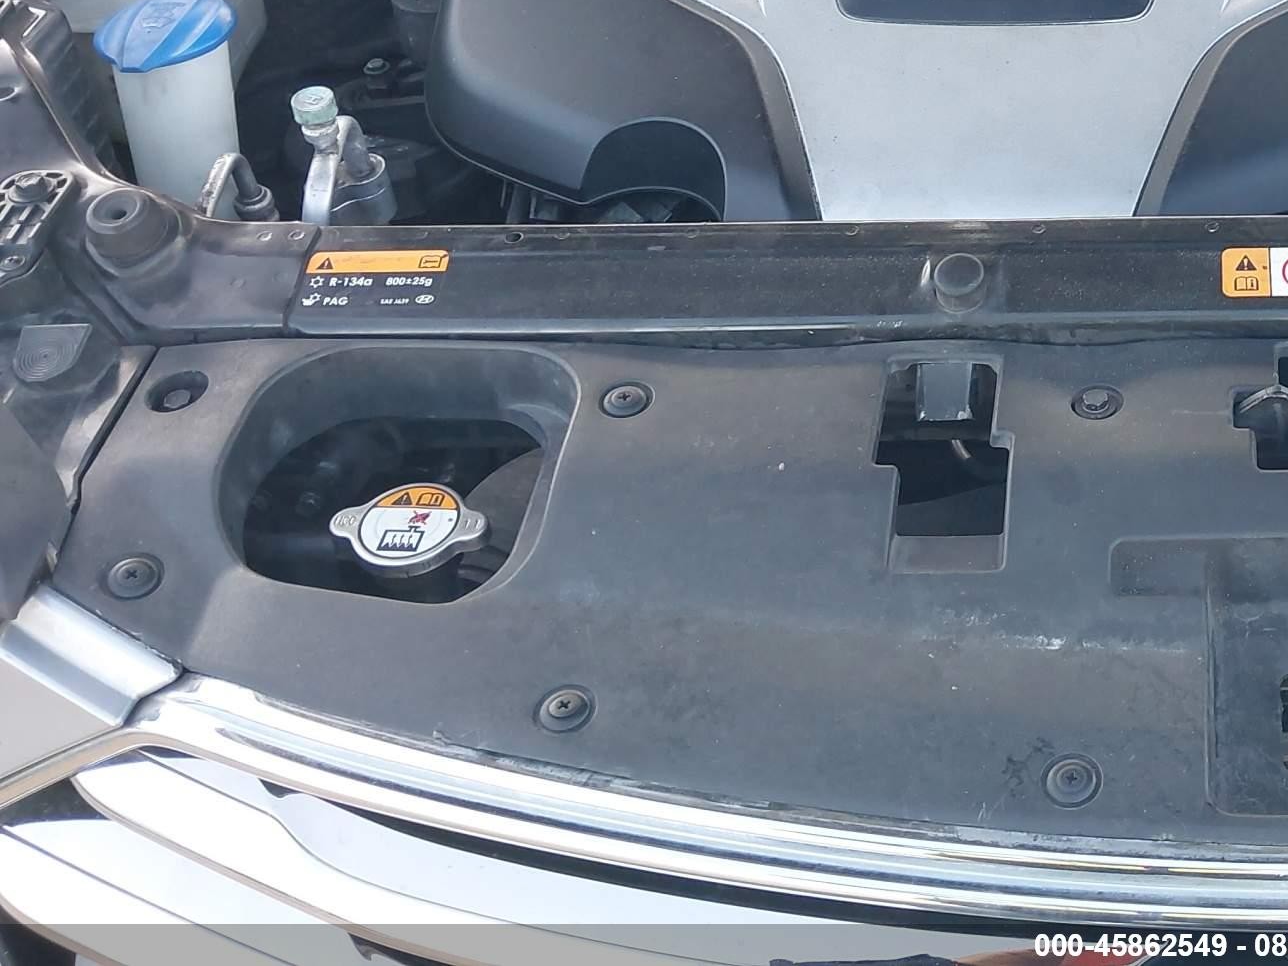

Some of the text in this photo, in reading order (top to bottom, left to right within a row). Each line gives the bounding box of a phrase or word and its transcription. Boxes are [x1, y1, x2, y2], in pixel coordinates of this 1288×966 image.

[329, 277, 433, 287] R-134a 800±25g
[322, 297, 349, 306] PAG
